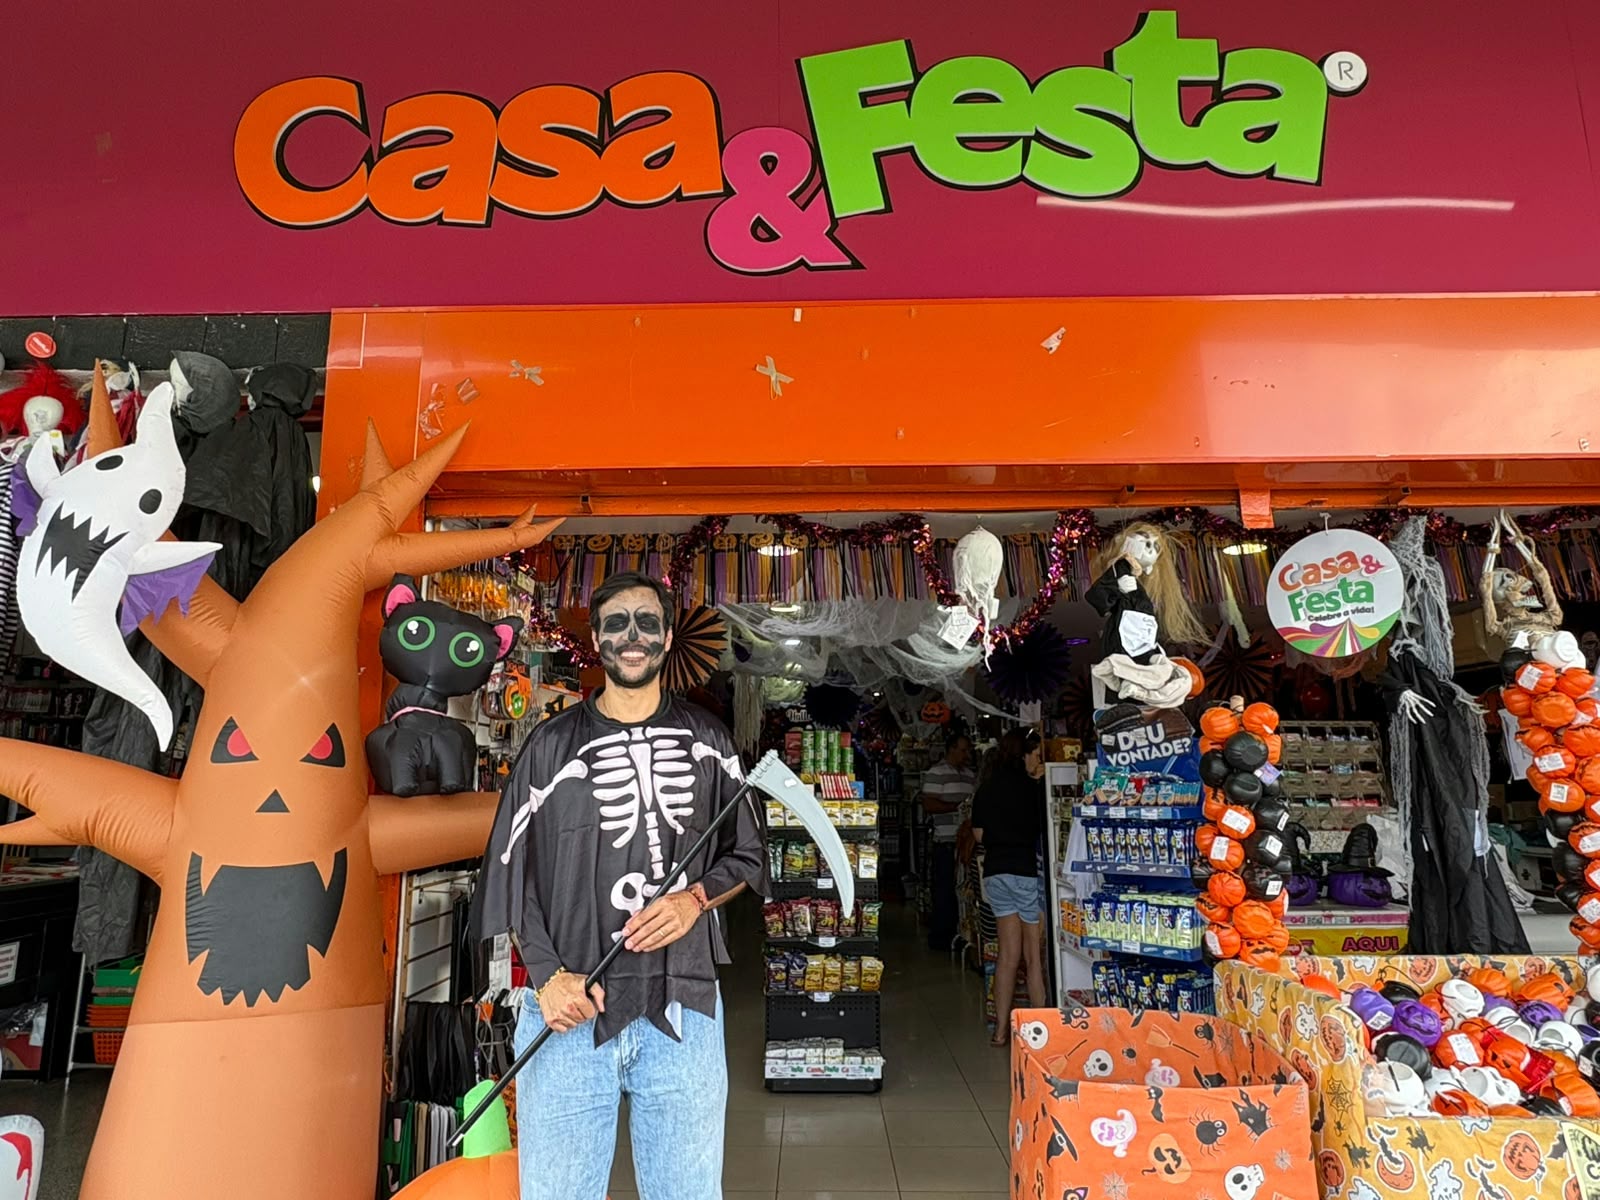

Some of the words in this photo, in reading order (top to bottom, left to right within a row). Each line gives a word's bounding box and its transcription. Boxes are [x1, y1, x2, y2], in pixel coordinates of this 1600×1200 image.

[233, 70, 735, 230] Casa
[704, 126, 866, 275] &
[796, 9, 1329, 220] Festa
[1278, 550, 1361, 591] Casa
[1361, 554, 1385, 575] &
[1287, 577, 1375, 622] Festa
[1308, 612, 1342, 622] Celebre
[1351, 606, 1375, 615] vida!
[1117, 723, 1165, 751] DEU
[1106, 738, 1191, 767] VONTADE?
[1342, 936, 1400, 952] AQUI
